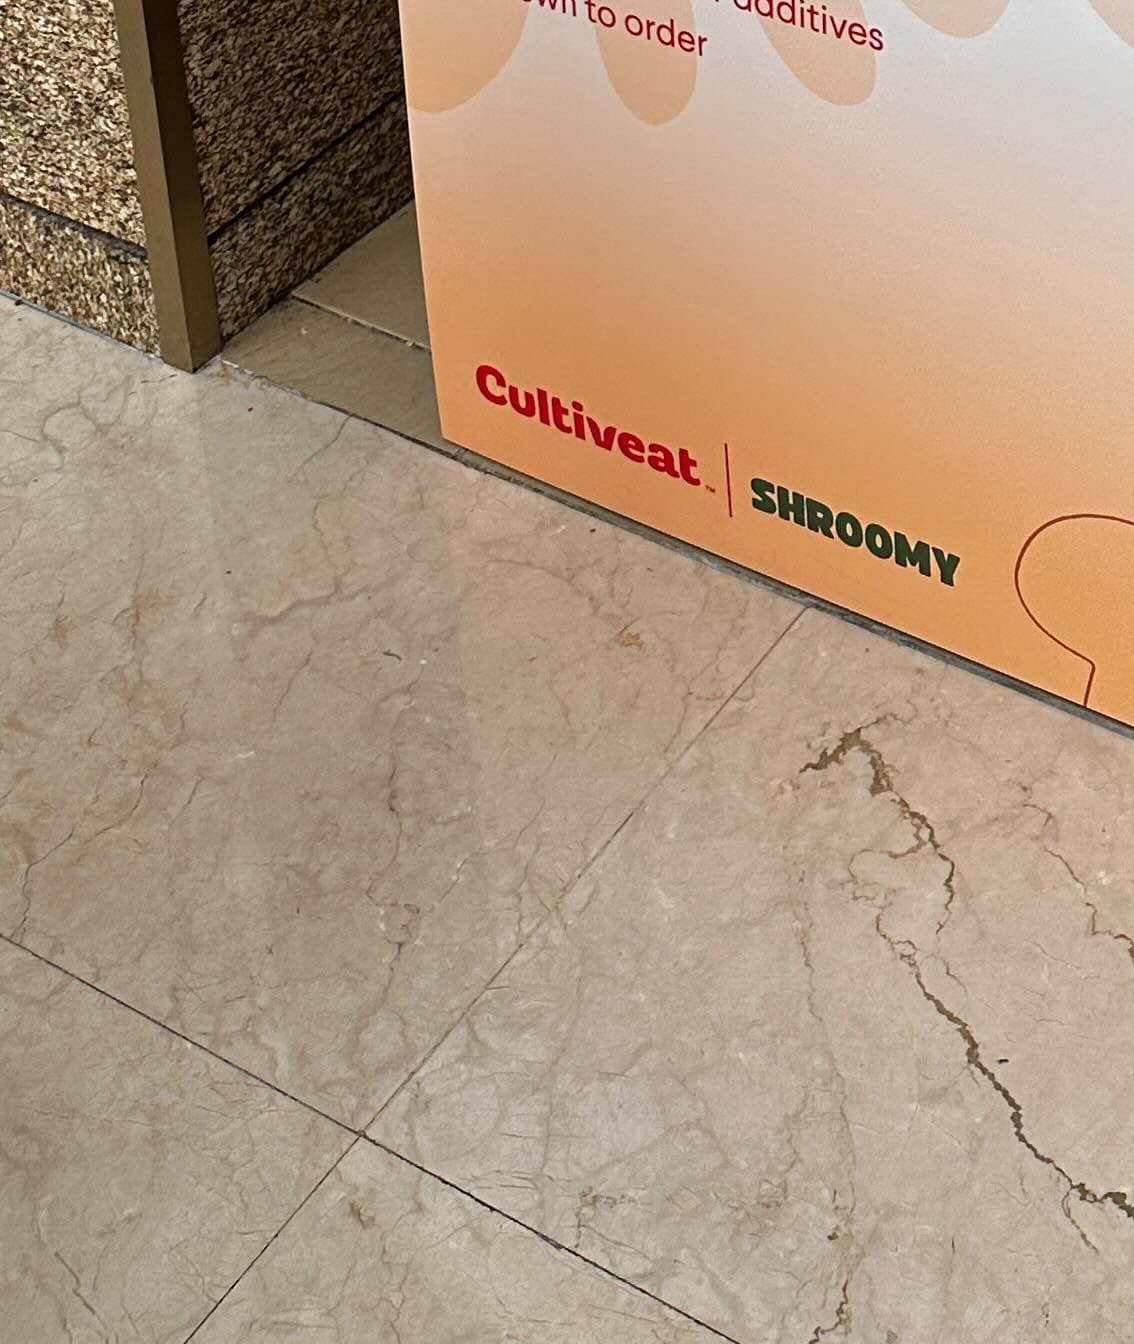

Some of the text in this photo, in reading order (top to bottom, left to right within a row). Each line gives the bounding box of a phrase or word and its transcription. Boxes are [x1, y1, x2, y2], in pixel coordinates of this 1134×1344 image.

[625, 5, 707, 57] order
[475, 364, 701, 487] Cultiveat
[750, 477, 960, 587] SHROOMY
